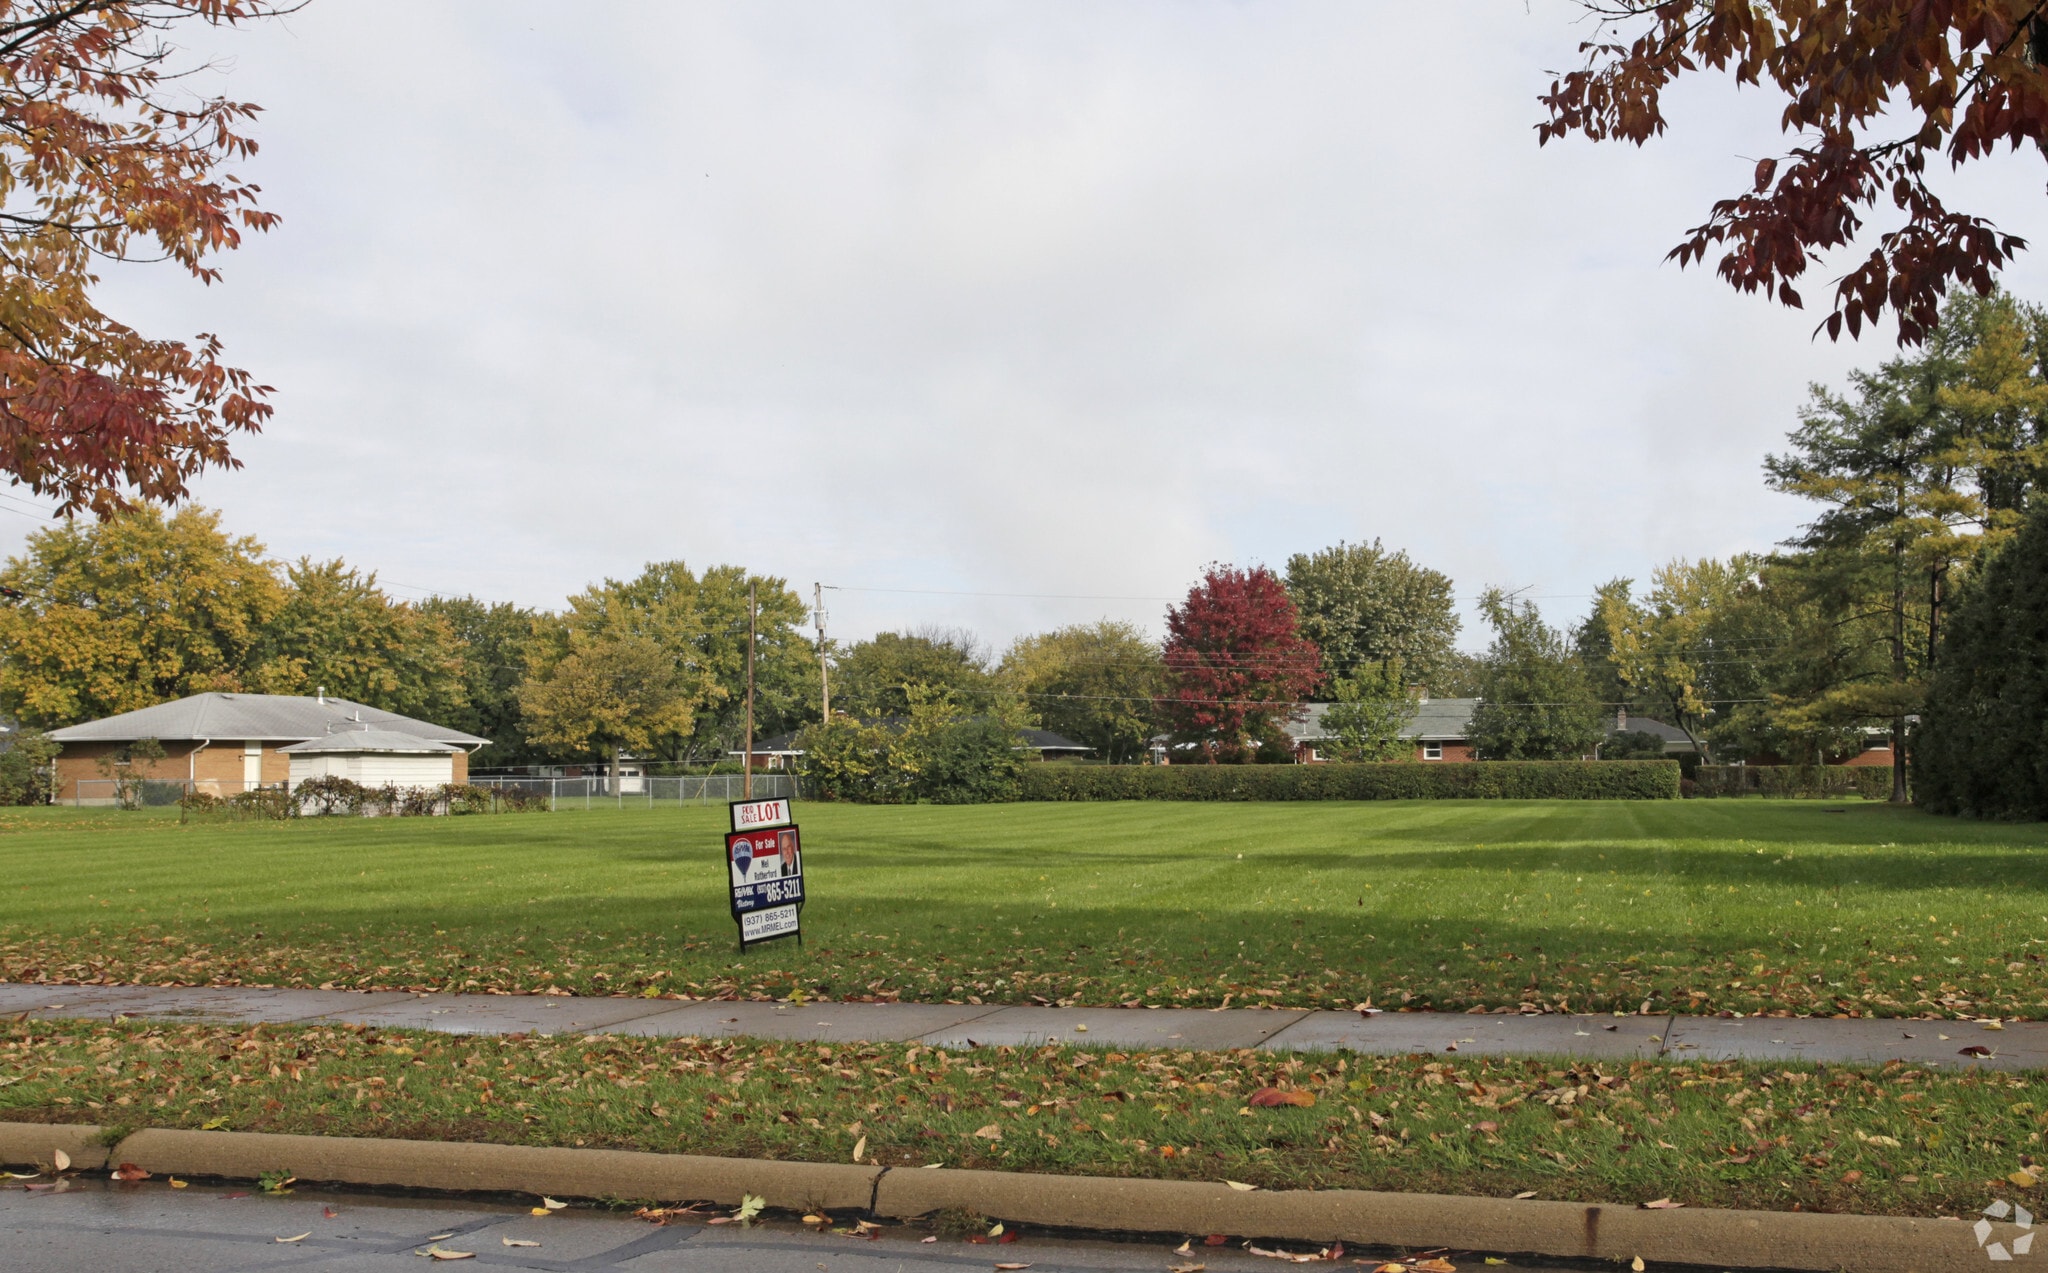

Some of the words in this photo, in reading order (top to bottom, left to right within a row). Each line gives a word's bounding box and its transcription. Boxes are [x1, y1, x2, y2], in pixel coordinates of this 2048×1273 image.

[742, 805, 754, 814] FOR
[757, 803, 780, 822] LOT
[741, 814, 757, 824] SALE
[755, 840, 764, 850] For
[764, 838, 776, 848] Sale
[766, 878, 801, 902] 865-5211
[744, 914, 762, 926] (937)
[765, 908, 795, 922] 865-5211
[744, 920, 796, 937] www.MRMEL.com
